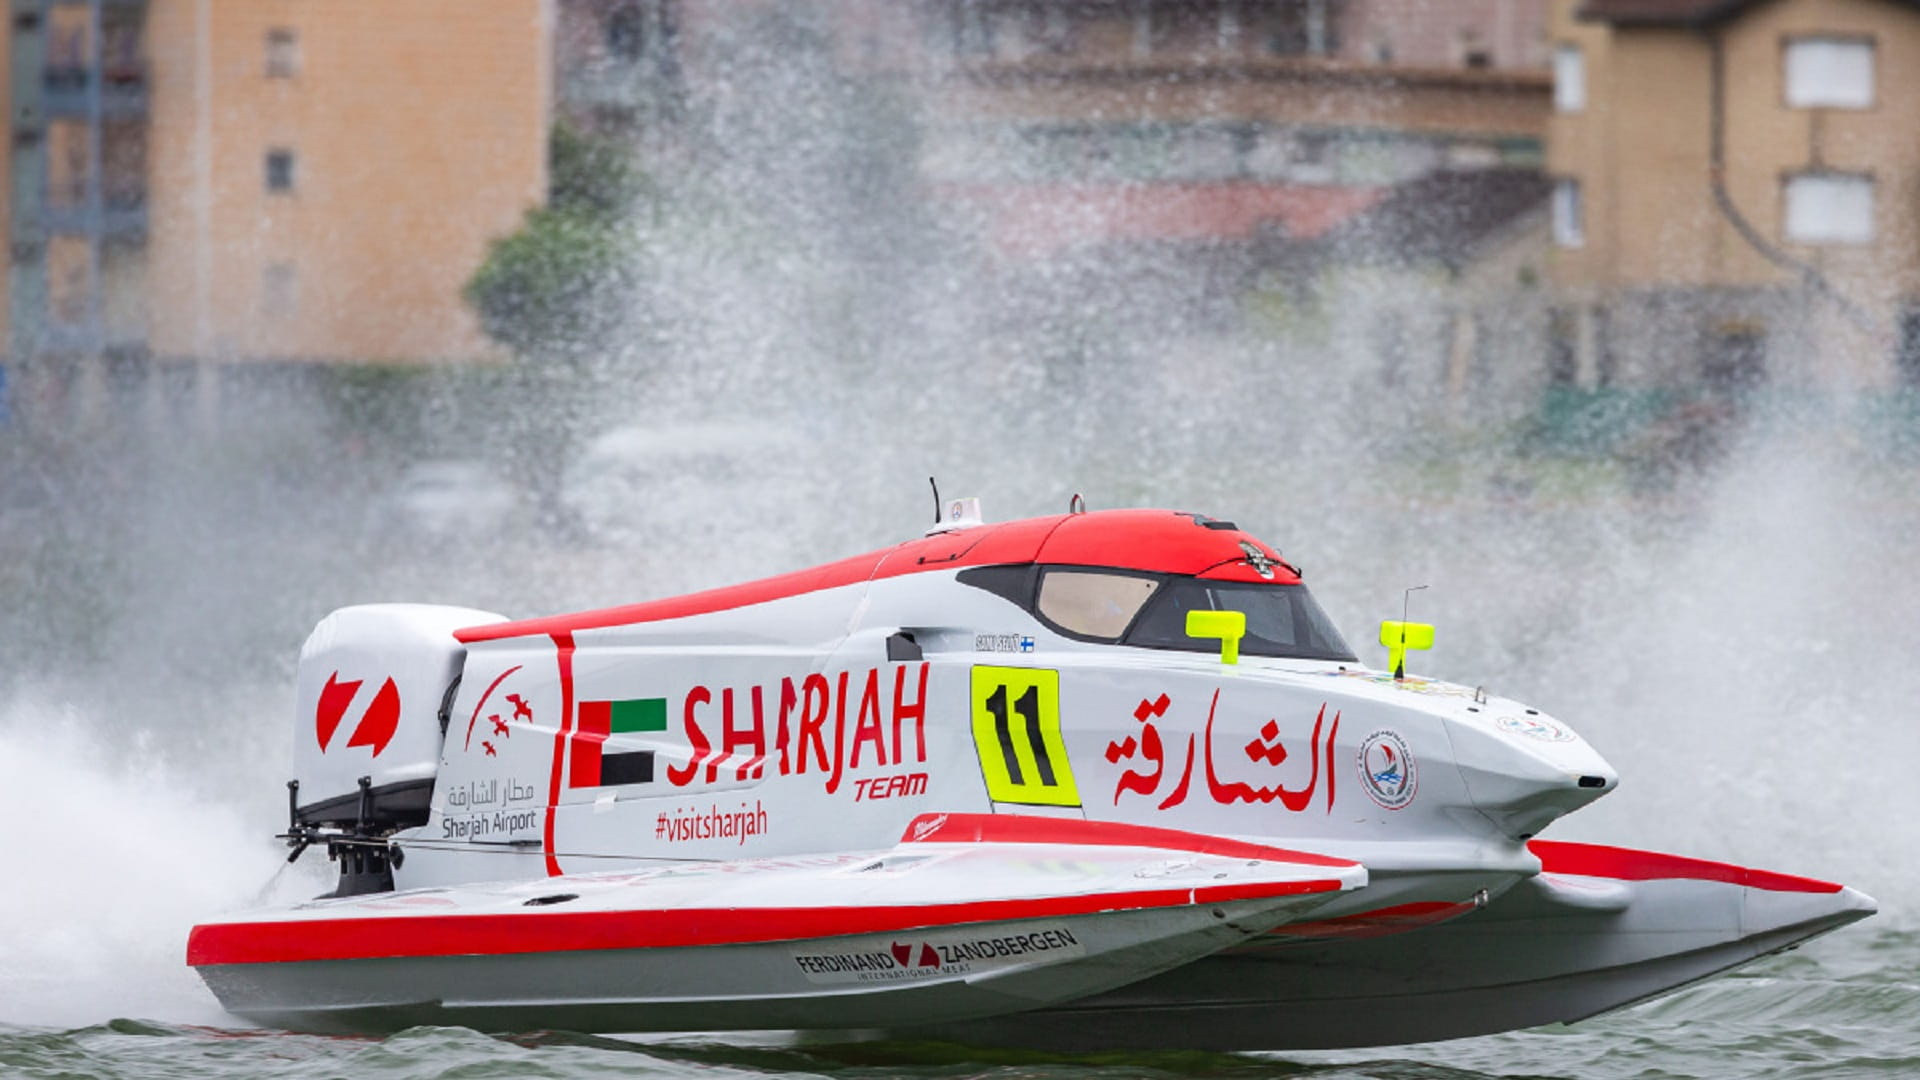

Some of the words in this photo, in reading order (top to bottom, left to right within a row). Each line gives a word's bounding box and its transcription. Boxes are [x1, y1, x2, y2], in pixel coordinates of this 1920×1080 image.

[667, 662, 930, 794] SHARJAH
[986, 684, 1059, 787] 11
[1104, 687, 1341, 816] الشارقة
[448, 778, 497, 812] الشارقة
[502, 777, 534, 808] مطار
[853, 772, 929, 803] TEAM
[442, 813, 489, 841] Sharjah
[492, 810, 537, 836] Airport
[655, 799, 768, 846] #visitsharjah
[795, 951, 894, 974] FERDINAND
[938, 928, 1078, 964] ZANDBERGEN
[856, 967, 939, 981] INTERNATIONAL
[942, 963, 972, 975] MEAT
